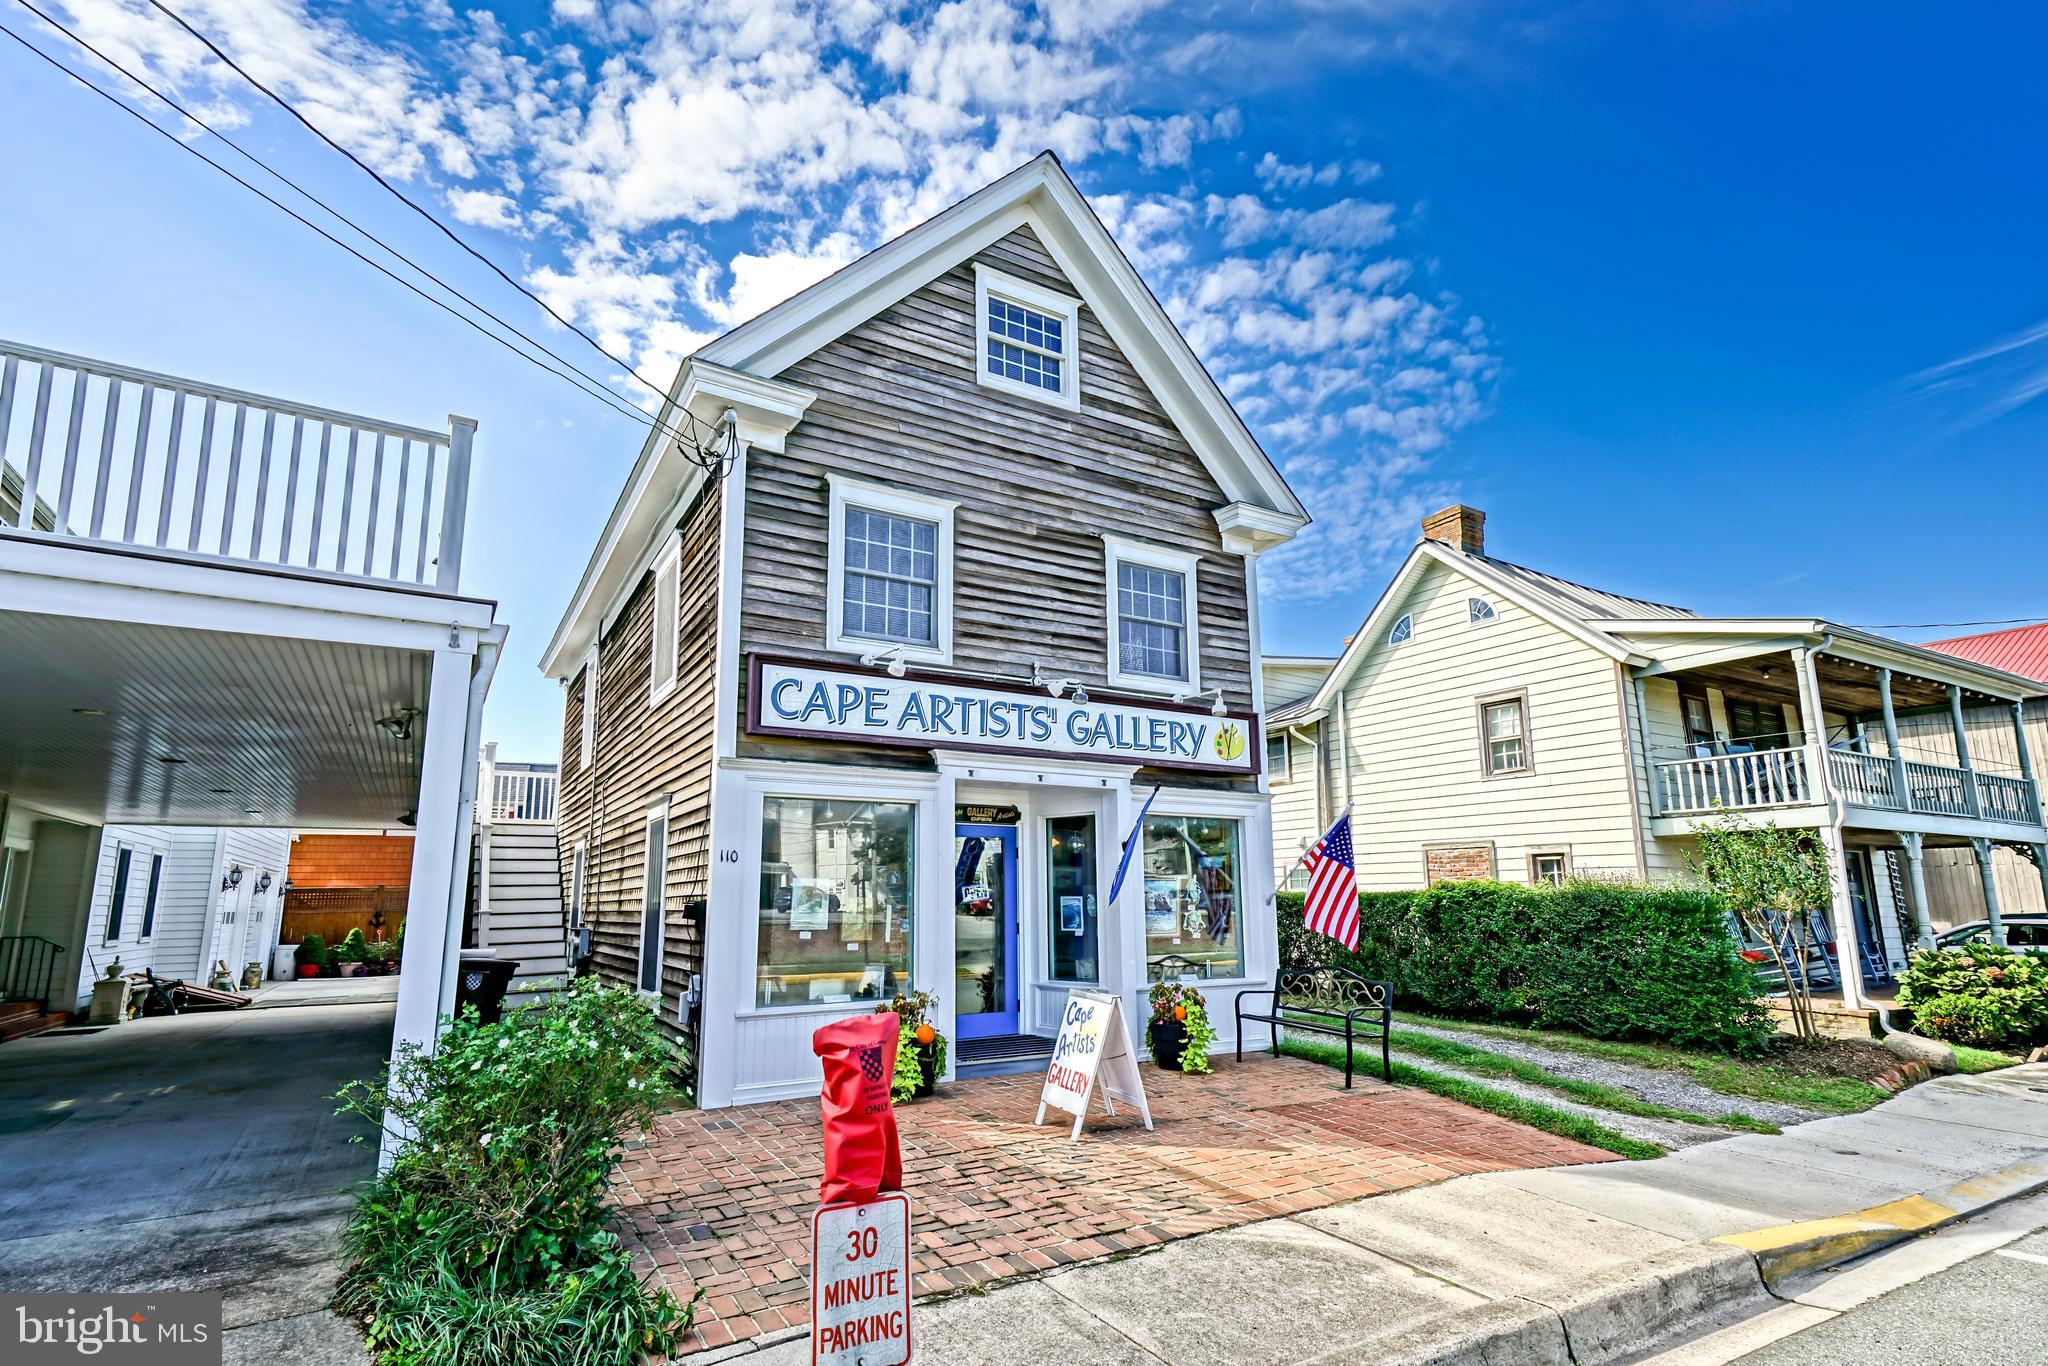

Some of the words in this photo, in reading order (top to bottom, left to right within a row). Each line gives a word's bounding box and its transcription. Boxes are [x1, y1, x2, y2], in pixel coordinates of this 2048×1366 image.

[771, 678, 889, 727] CAPE
[896, 690, 1057, 742] ARTISTS'
[1066, 709, 1207, 760] GALLERY
[967, 807, 997, 817] GALLERY
[720, 849, 738, 863] 110
[1066, 1001, 1094, 1031] Cape
[1047, 1062, 1091, 1098] GALLERY
[865, 1101, 888, 1115] ONLY
[845, 1226, 879, 1262] 30
[824, 1268, 899, 1311] MINUTE
[820, 1310, 903, 1354] PARKING
